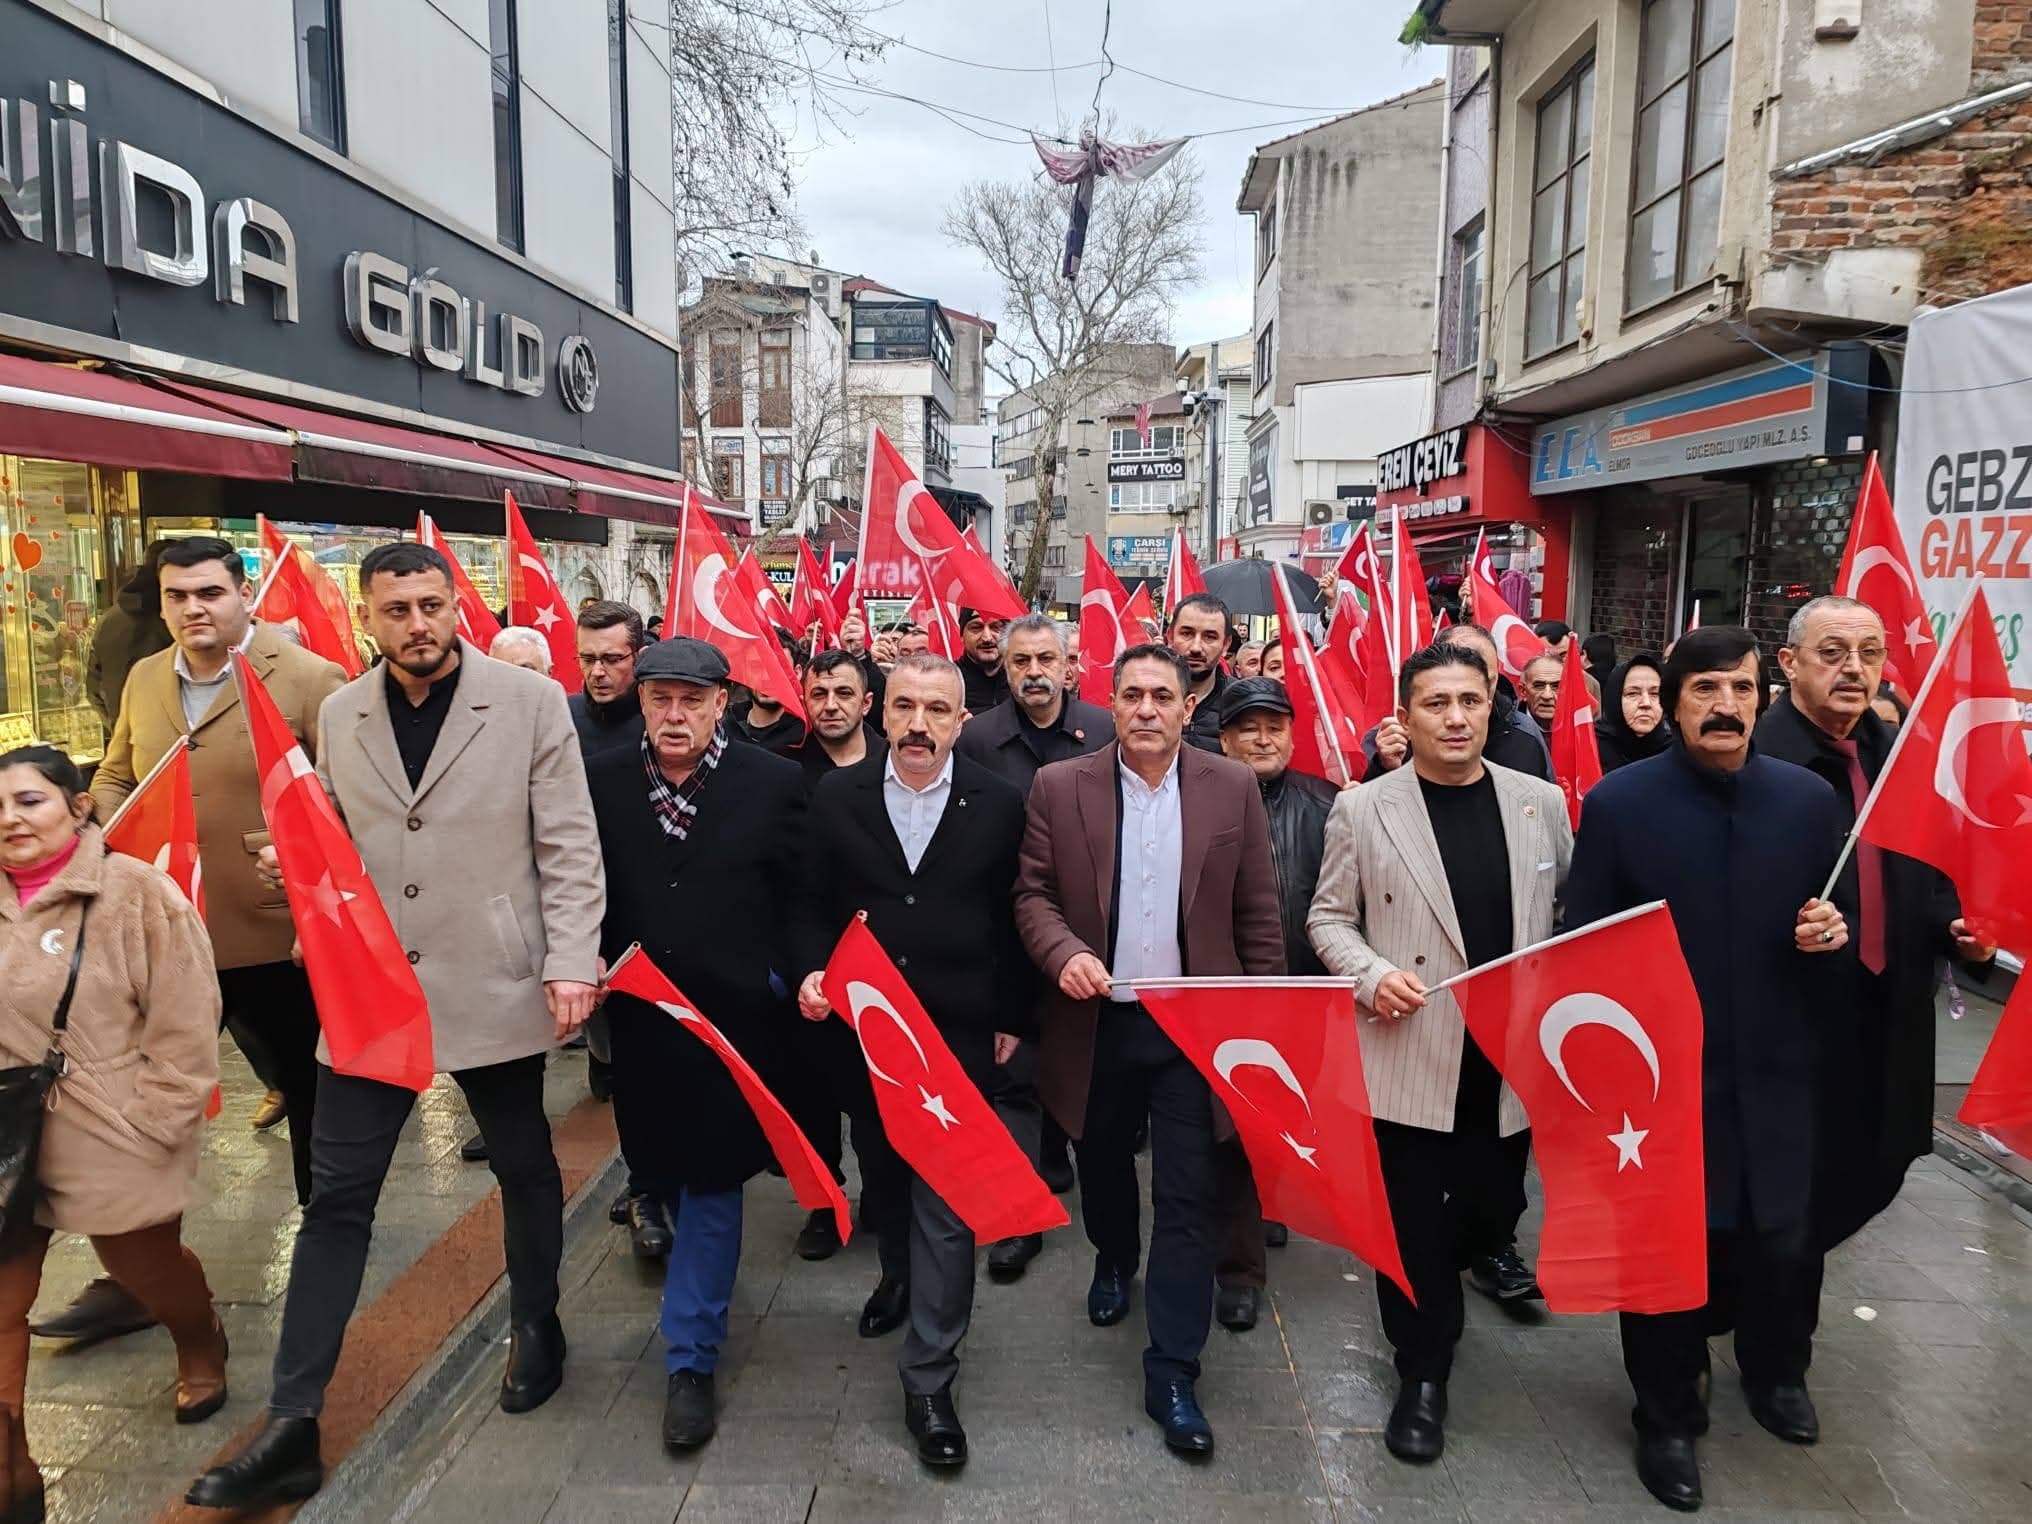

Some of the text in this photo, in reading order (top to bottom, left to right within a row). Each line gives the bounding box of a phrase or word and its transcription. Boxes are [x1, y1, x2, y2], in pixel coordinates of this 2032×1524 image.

[1736, 433, 1760, 451] YAPI
[1110, 462, 1183, 478] MERY TATTOO
[1378, 429, 1461, 497] EREN ÇEYİZ
[1920, 515, 2032, 580] GAZZ
